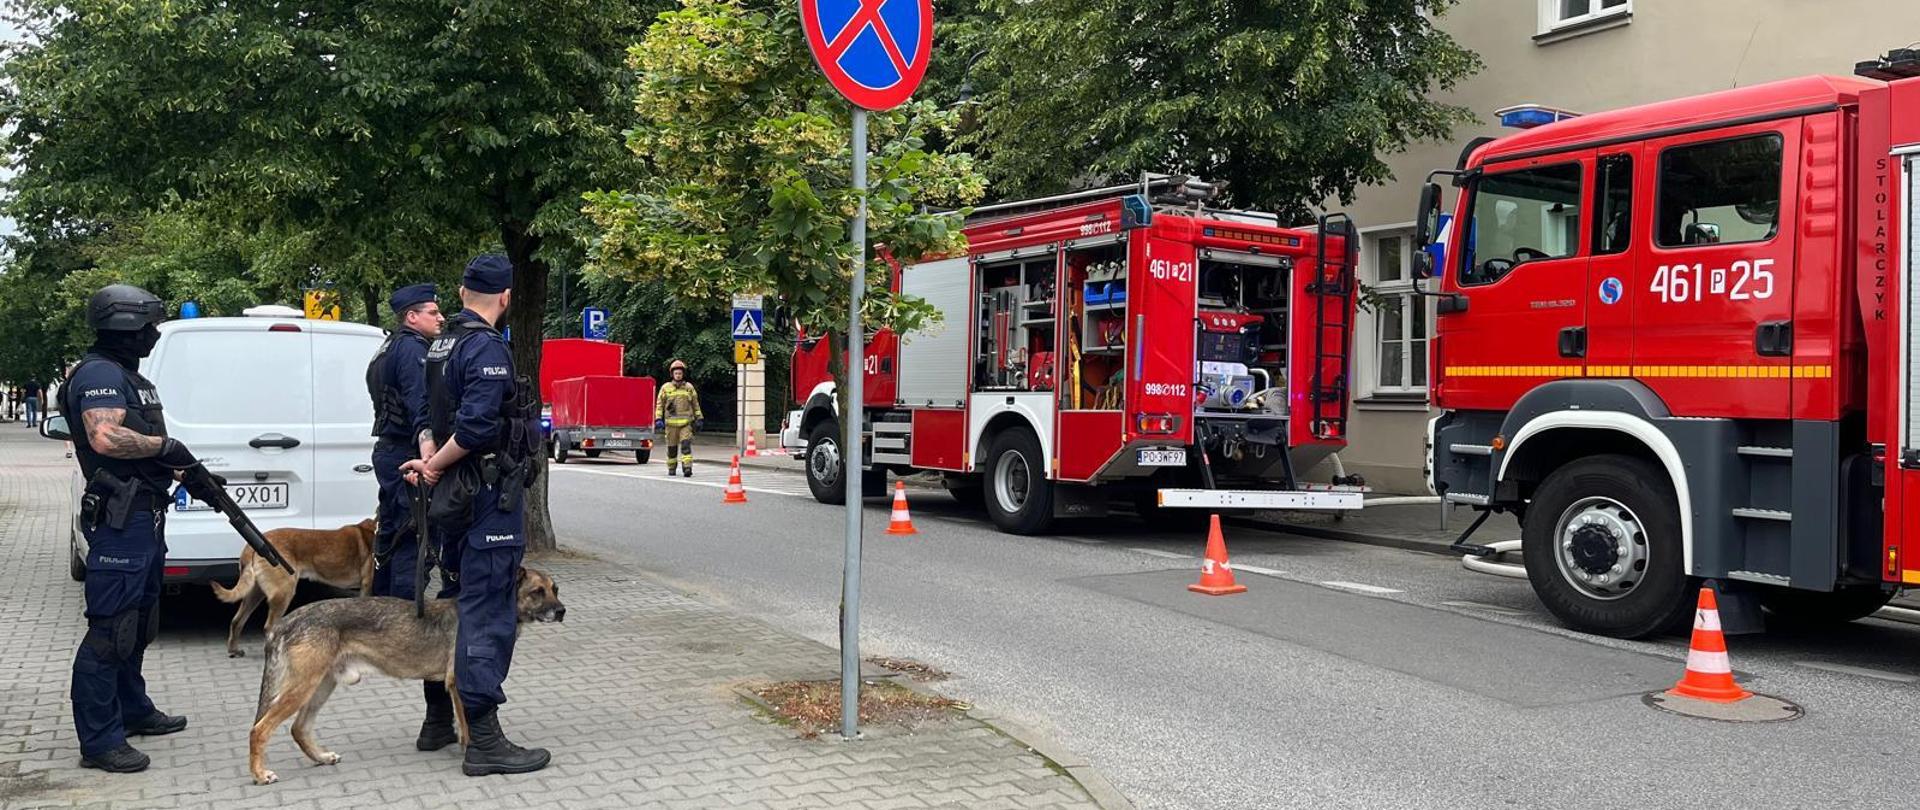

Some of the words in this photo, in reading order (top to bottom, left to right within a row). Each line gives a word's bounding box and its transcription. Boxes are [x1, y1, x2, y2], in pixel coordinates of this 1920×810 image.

[1875, 158, 1887, 321] STOLARCZYK
[1150, 259, 1171, 280] 461
[1179, 262, 1192, 282] 21
[1650, 263, 1703, 303] 461
[1730, 259, 1774, 300] 25
[589, 311, 604, 330] P
[85, 388, 118, 398] POLICJA
